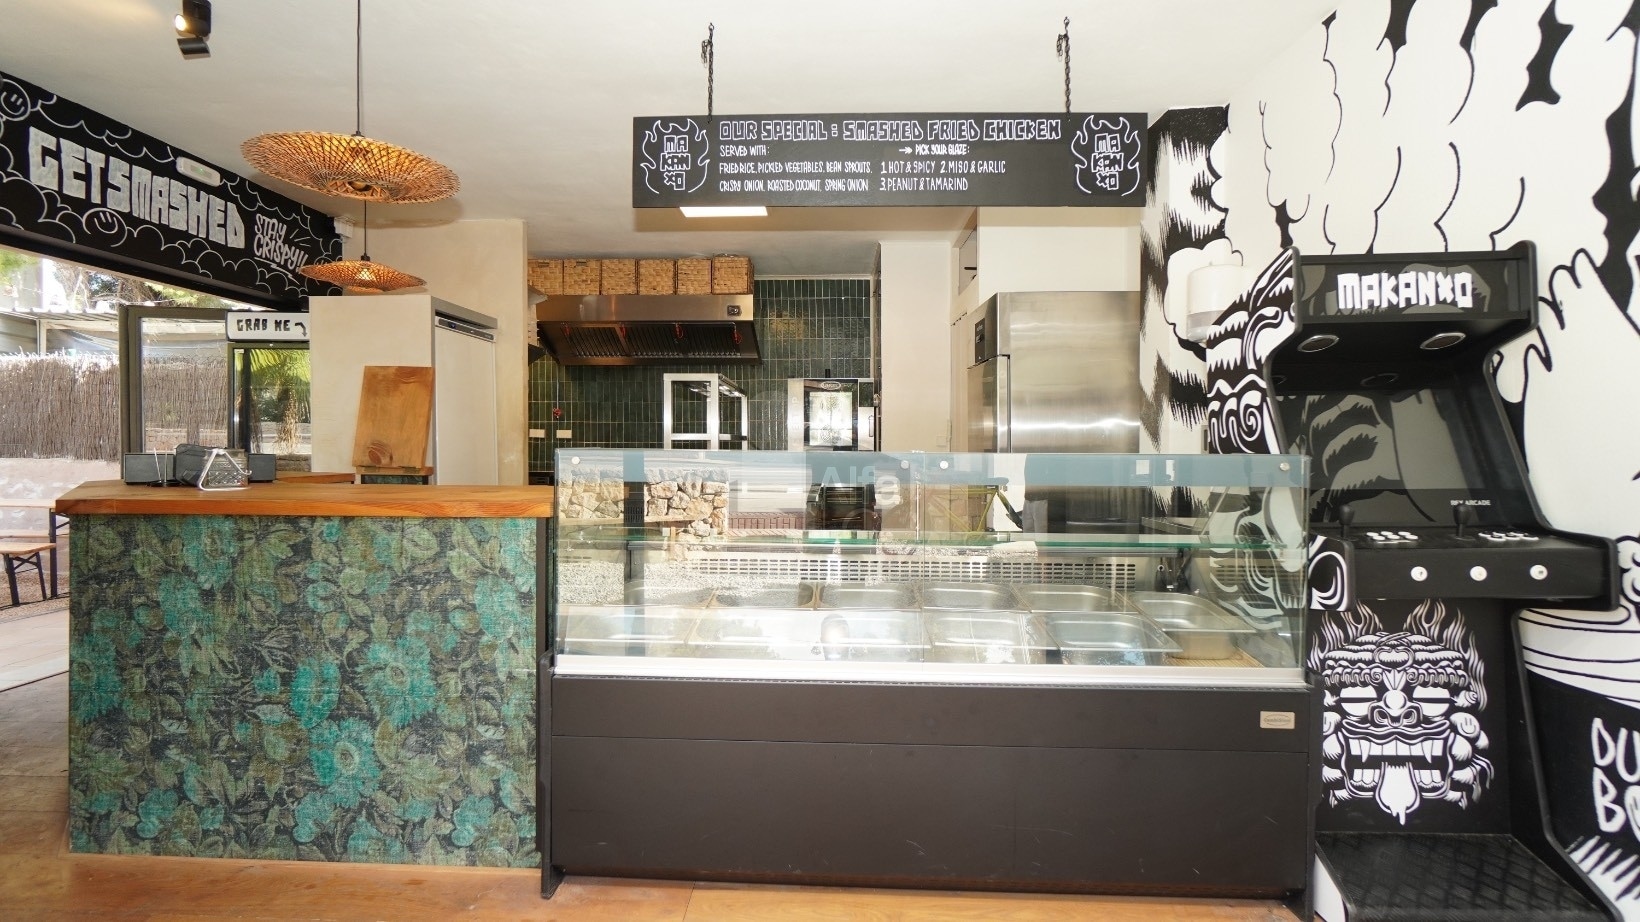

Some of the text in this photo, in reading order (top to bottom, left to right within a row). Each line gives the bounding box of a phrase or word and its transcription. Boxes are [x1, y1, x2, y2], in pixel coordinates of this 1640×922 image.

[719, 121, 758, 141] OUR
[761, 120, 828, 141] SPECIAL
[843, 120, 924, 141] SMASHED
[927, 119, 981, 141] FRIED
[983, 119, 1062, 140] CHICKEN
[663, 135, 689, 153] MA
[719, 145, 748, 157] SERVED
[915, 144, 930, 156] PICK
[931, 144, 948, 155] YOUR
[719, 162, 739, 175] FRIED
[758, 161, 783, 174] PICKLED
[826, 160, 842, 173] BEAN
[888, 160, 904, 173] HOT
[905, 161, 912, 174] &
[913, 160, 936, 174] SPICY
[948, 160, 969, 173] MISO
[970, 160, 976, 173] &
[977, 160, 1006, 173] GARLIC
[28, 126, 246, 249] GET SMASHED
[719, 179, 742, 192] CRISPY
[767, 179, 794, 192] ROASTED
[824, 178, 846, 191] SPRING
[847, 178, 869, 192] ONION
[887, 177, 918, 191] PEANUT
[918, 178, 925, 191] &
[925, 177, 969, 191] TAMARIND
[254, 213, 287, 243] STAY
[254, 234, 309, 274] CRISPY!!
[1337, 271, 1474, 310] MAKANXO
[236, 318, 291, 332] GRAB ME
[1465, 498, 1491, 506] ARCADE
